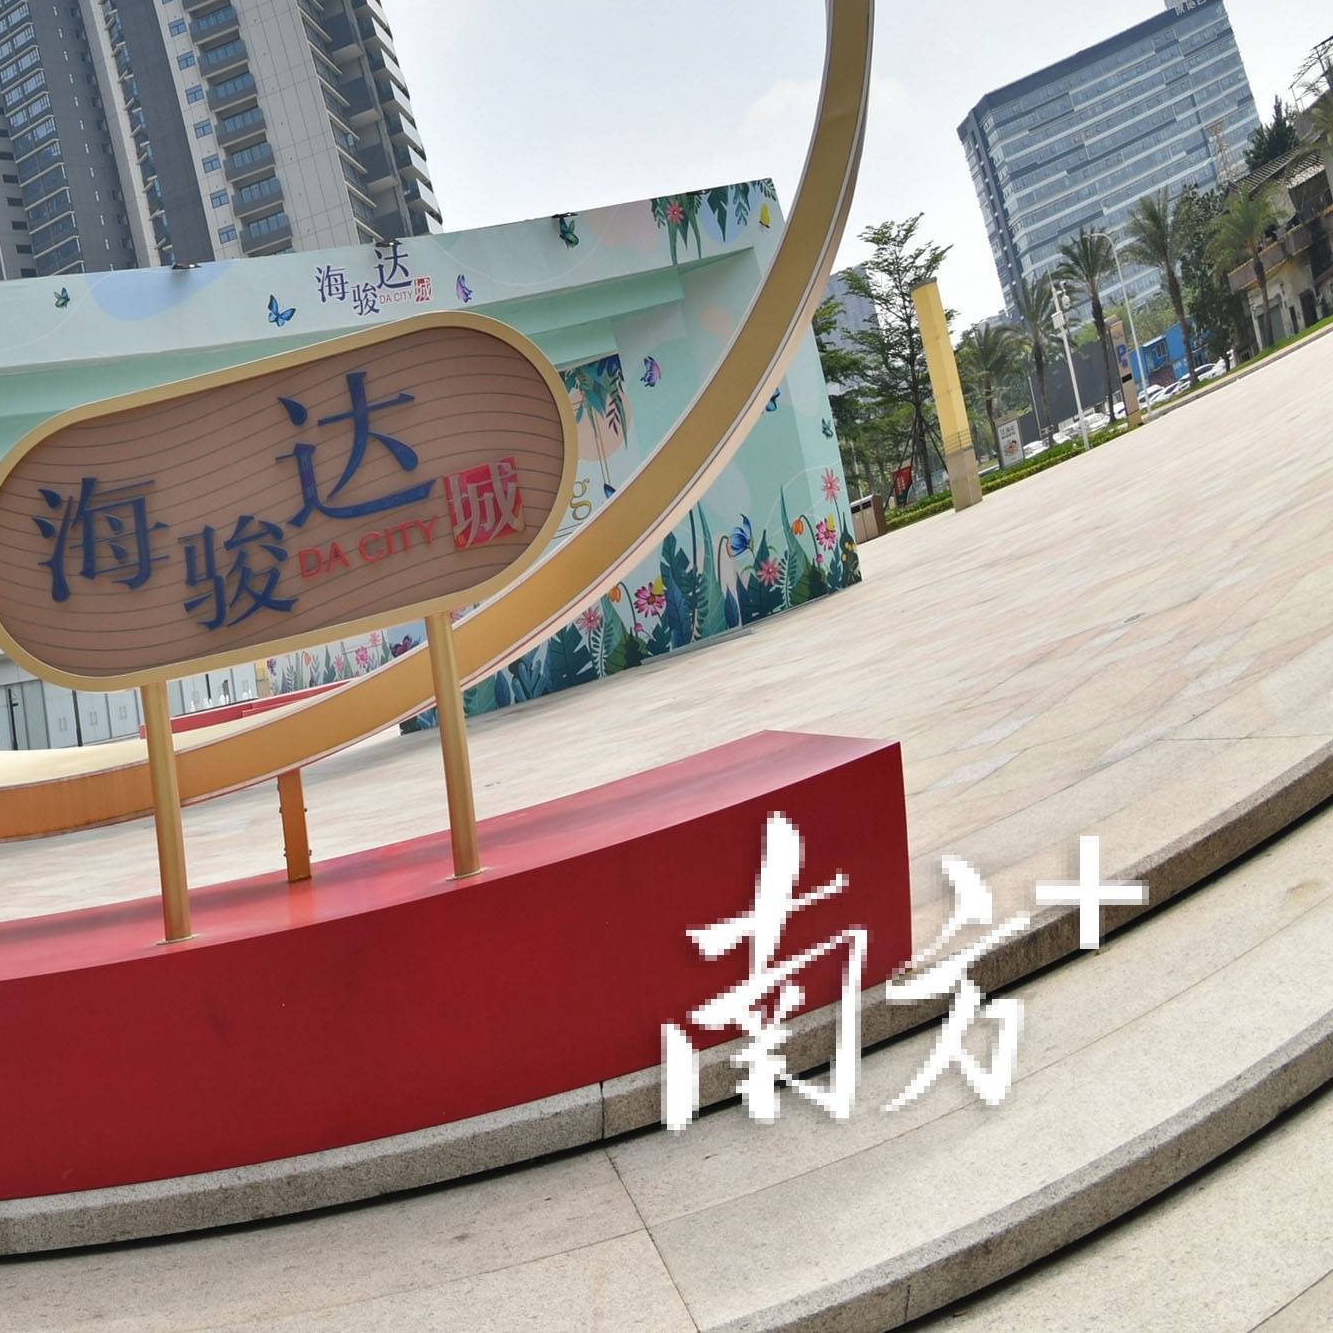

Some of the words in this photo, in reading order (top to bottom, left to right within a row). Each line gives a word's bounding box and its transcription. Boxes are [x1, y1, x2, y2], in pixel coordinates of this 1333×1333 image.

[315, 242, 431, 316] 海骏达城
[379, 295, 392, 305] DA
[393, 291, 413, 302] CITY
[31, 370, 524, 631] 海骏达城
[296, 547, 350, 581] DA
[356, 512, 440, 564] CITY
